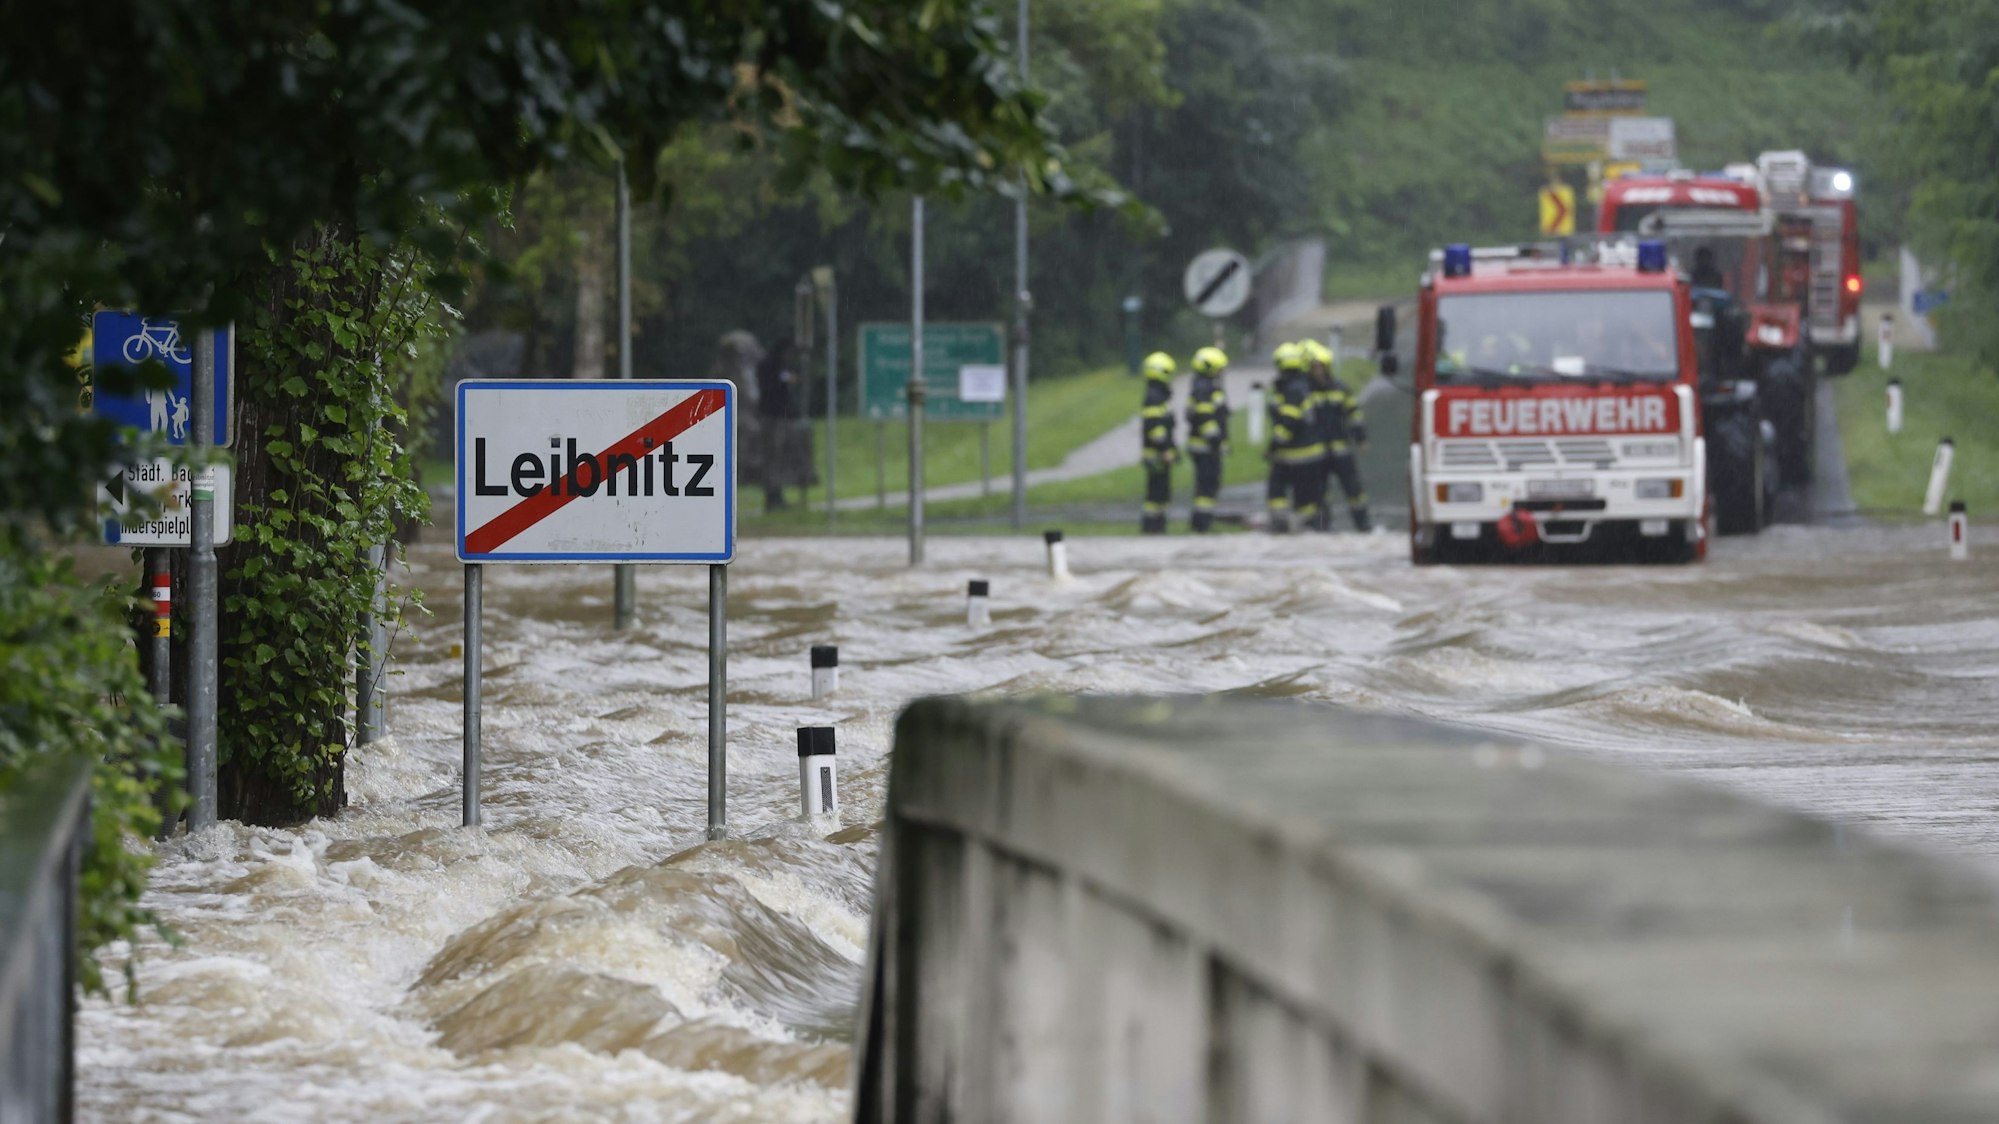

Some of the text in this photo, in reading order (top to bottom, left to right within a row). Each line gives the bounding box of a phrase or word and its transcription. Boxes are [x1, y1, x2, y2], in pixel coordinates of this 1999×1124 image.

[1450, 396, 1666, 433] FEUERWEHR
[128, 463, 165, 482] Städt.
[475, 437, 715, 498] Leibnitz
